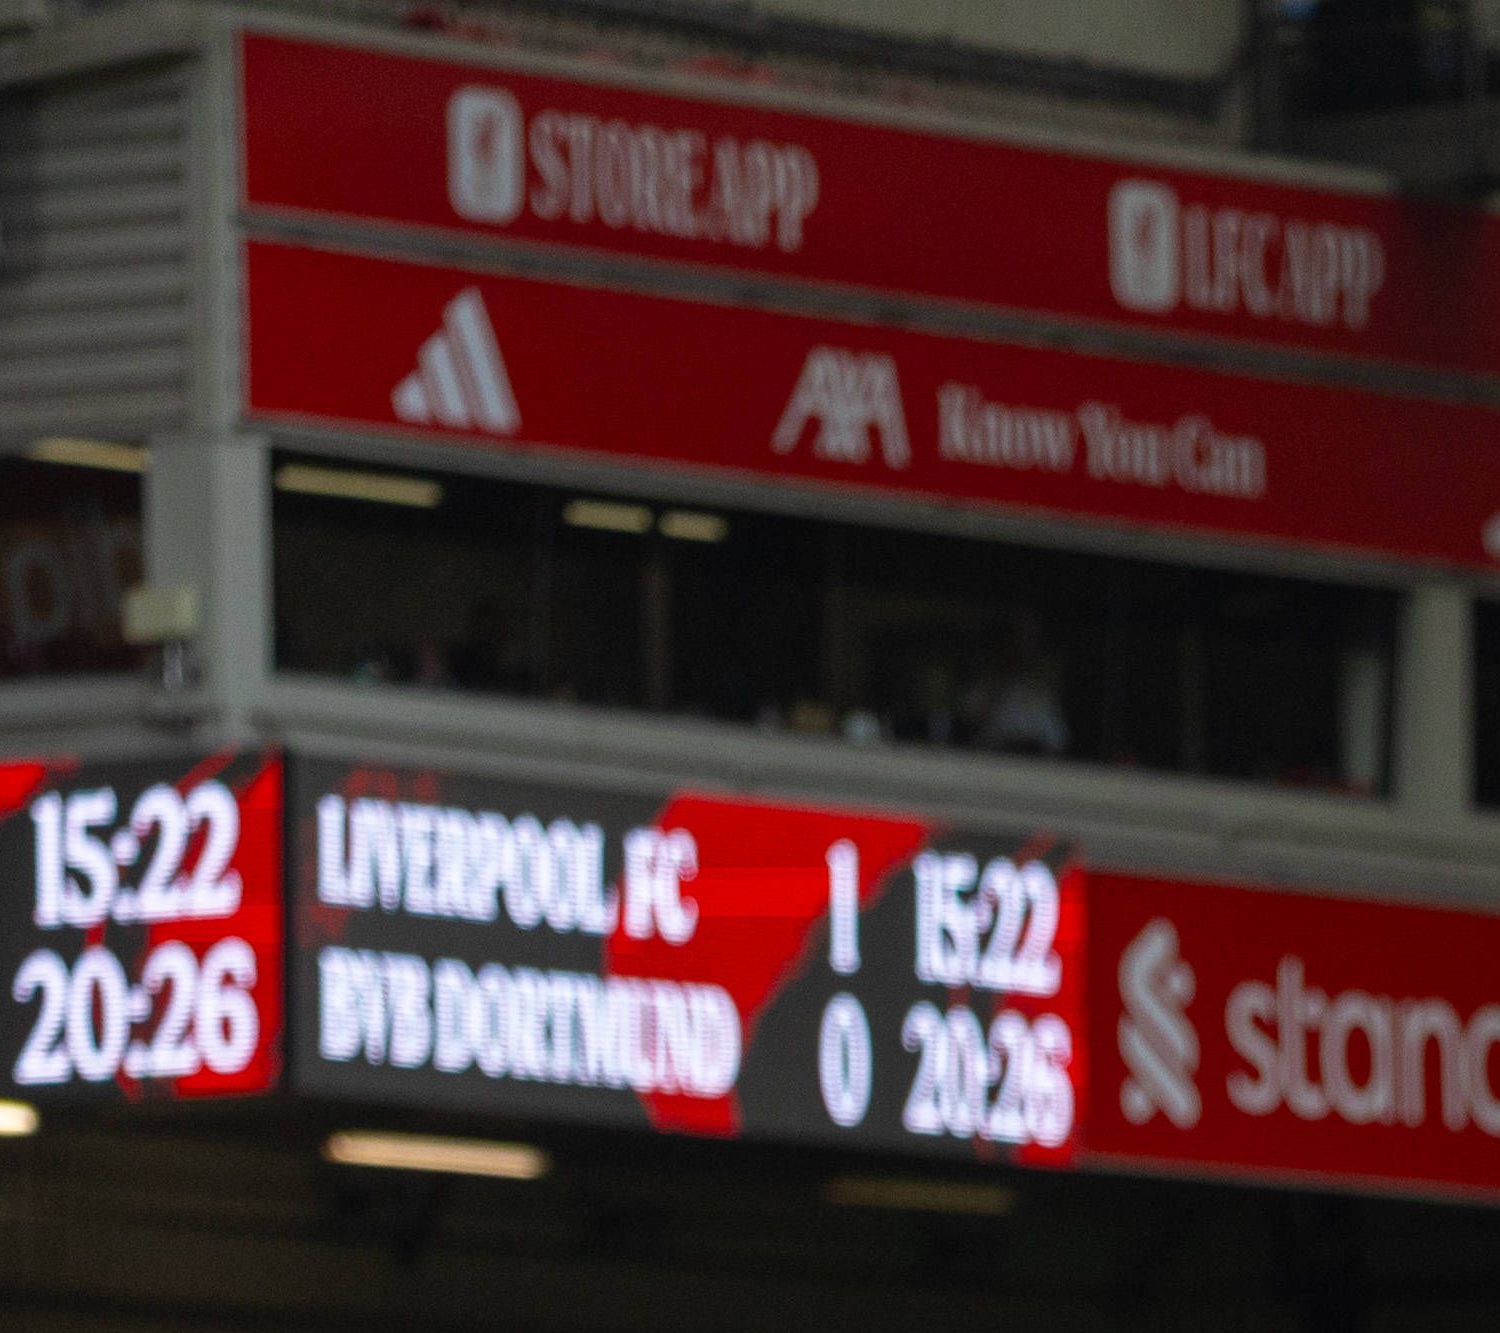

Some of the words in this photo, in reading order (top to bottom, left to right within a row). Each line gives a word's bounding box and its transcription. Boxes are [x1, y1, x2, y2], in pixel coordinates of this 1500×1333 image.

[528, 110, 703, 234] STORE
[703, 138, 822, 254] APP
[1181, 203, 1274, 318] LFC
[1277, 222, 1384, 330] APP
[770, 344, 912, 470] AXA
[937, 383, 1075, 472] Know
[1076, 400, 1168, 486] You
[1167, 413, 1267, 498] Can
[30, 778, 244, 930] 15:22
[316, 794, 618, 938] LIVERPOOL
[622, 826, 700, 945] FC
[825, 837, 862, 975] 1
[912, 848, 1064, 998] 15:22
[12, 935, 261, 1087] 20:26
[318, 946, 433, 1068] BVB
[432, 957, 743, 1100] DORTMUND
[817, 991, 874, 1129] 0
[901, 1001, 1076, 1149] 20:26
